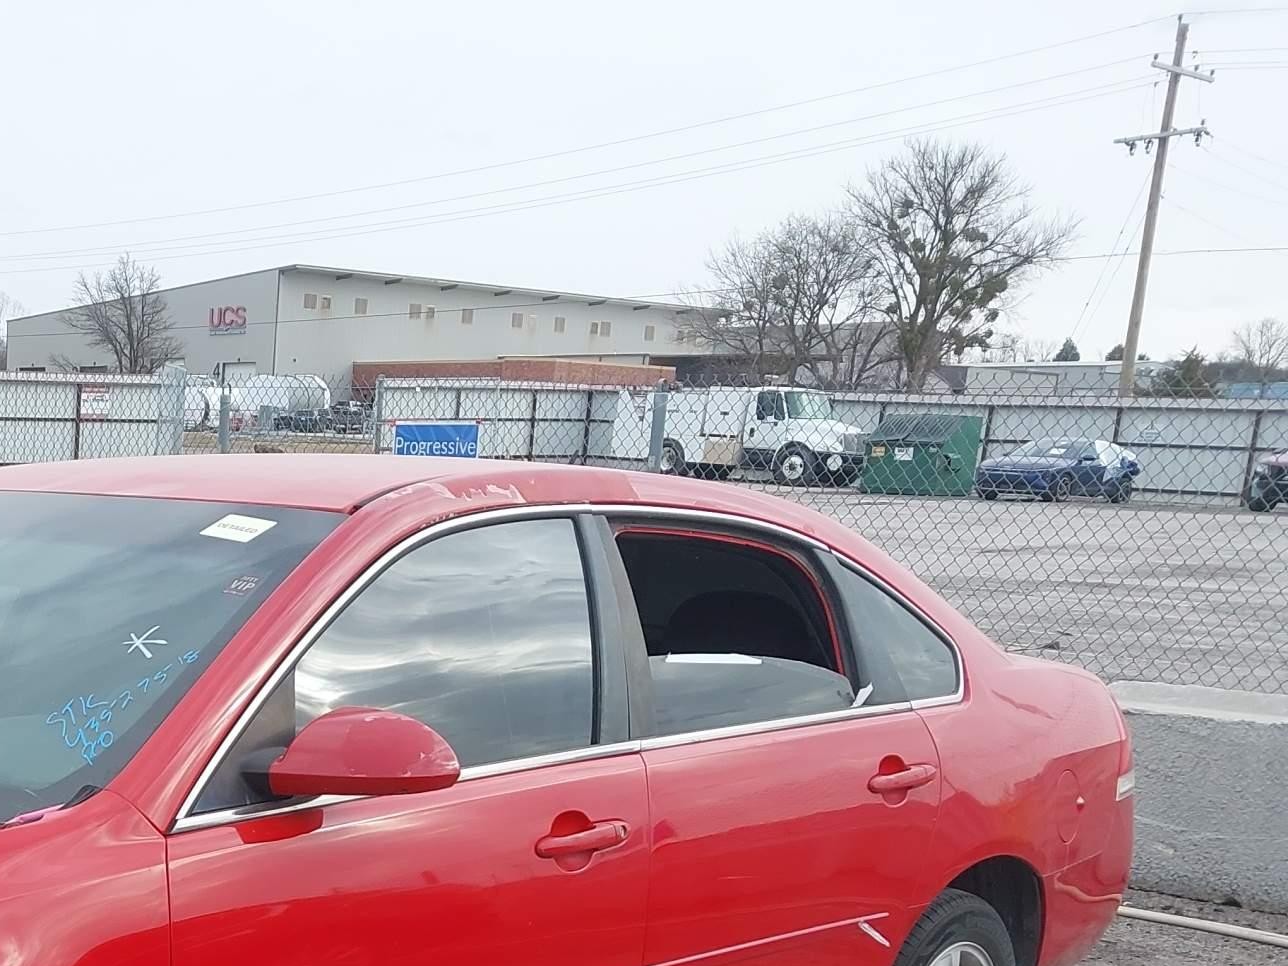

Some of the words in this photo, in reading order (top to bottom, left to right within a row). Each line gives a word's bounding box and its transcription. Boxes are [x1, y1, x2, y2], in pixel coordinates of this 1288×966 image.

[209, 306, 247, 328] UCS
[396, 436, 476, 456] Progressive
[46, 694, 109, 736] STK
